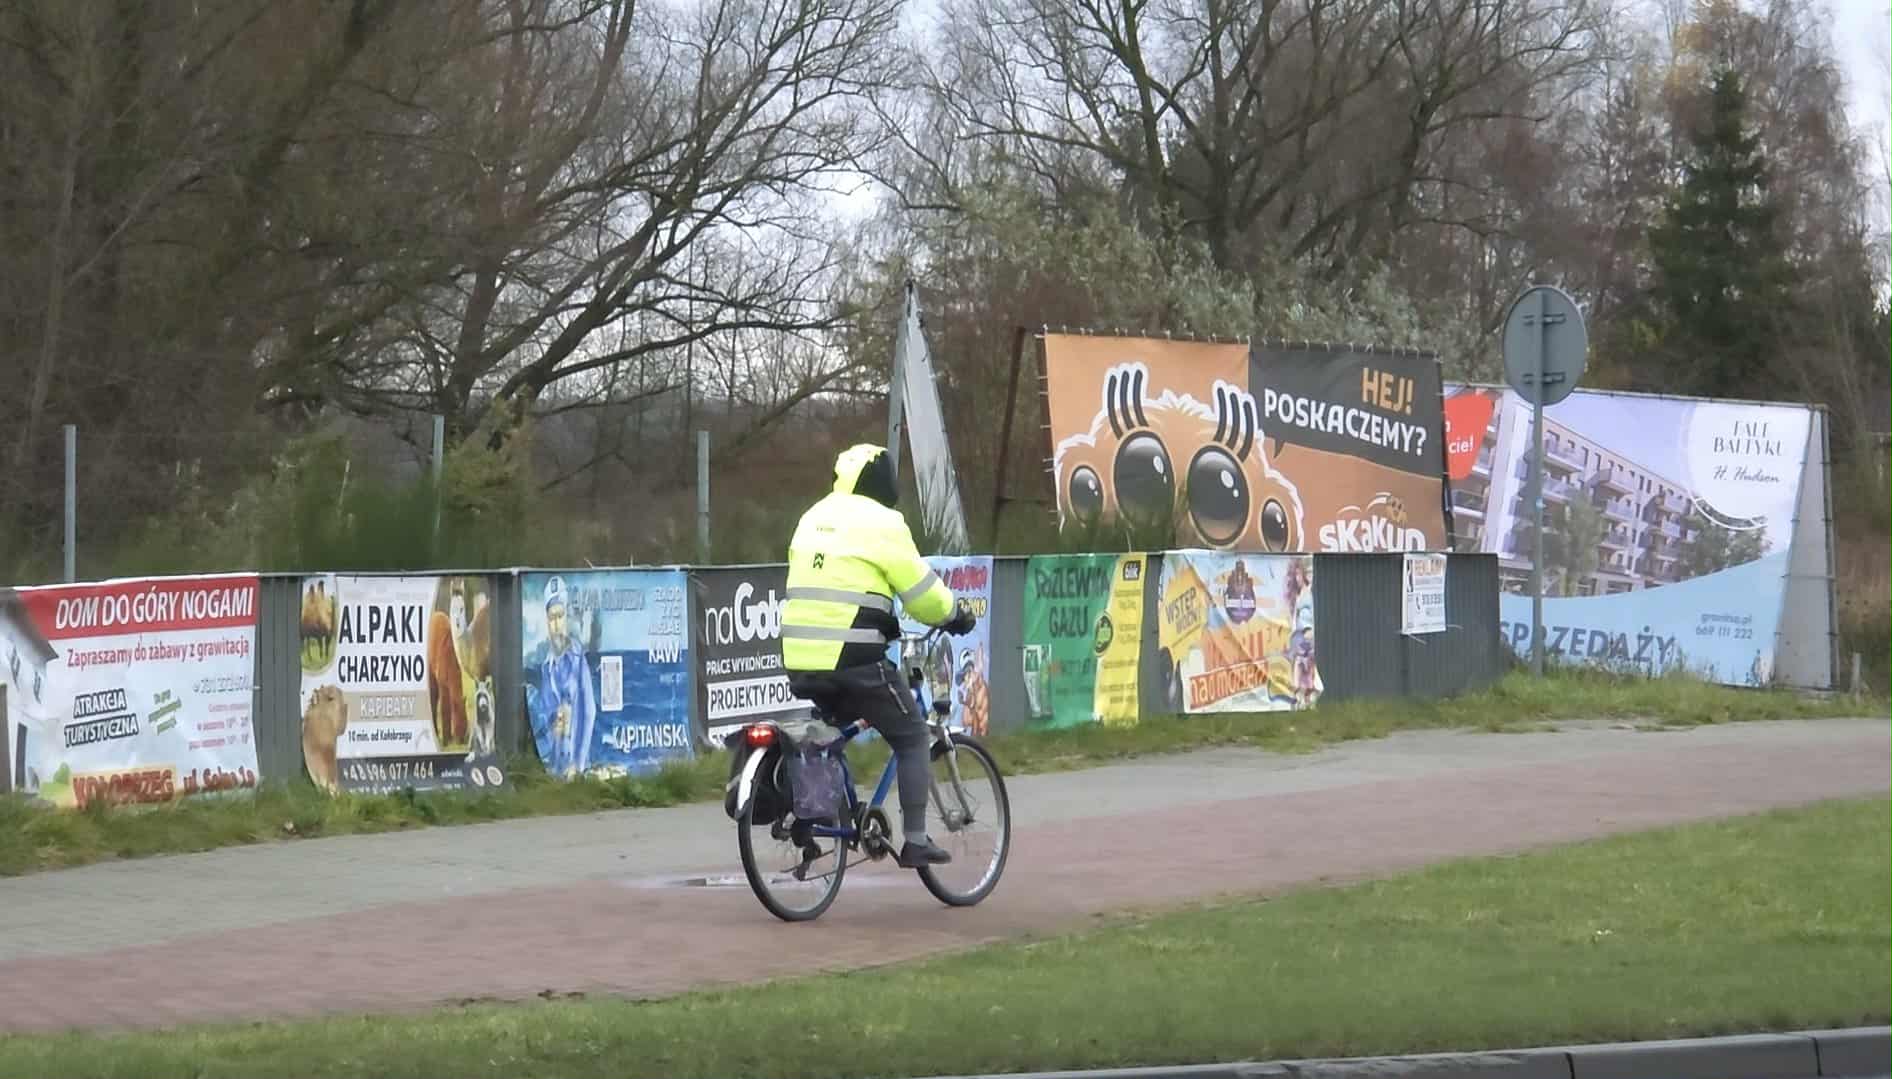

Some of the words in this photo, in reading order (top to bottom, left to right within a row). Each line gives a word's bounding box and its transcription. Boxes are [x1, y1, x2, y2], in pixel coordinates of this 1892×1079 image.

[1362, 367, 1414, 415] HEJ!
[1264, 388, 1427, 456] POSKACZEMY?
[56, 597, 98, 629] DOM
[102, 594, 130, 627] DO
[133, 586, 180, 623] GÓRY
[182, 587, 254, 619] NOGAMI
[1048, 605, 1089, 638] GAZU
[339, 605, 424, 644] ALPAKI
[67, 647, 133, 671] Zapraszamy
[134, 640, 147, 660] do
[149, 640, 188, 663] zabawy
[188, 646, 195, 657] z
[338, 654, 425, 684] CHARZYNO
[706, 659, 731, 676] PRACE
[73, 688, 127, 718] ATRAKCJA
[359, 697, 416, 719] KAPIBARY
[710, 683, 767, 712] PROJEKTY
[64, 714, 140, 748] TURYSTYCZNA
